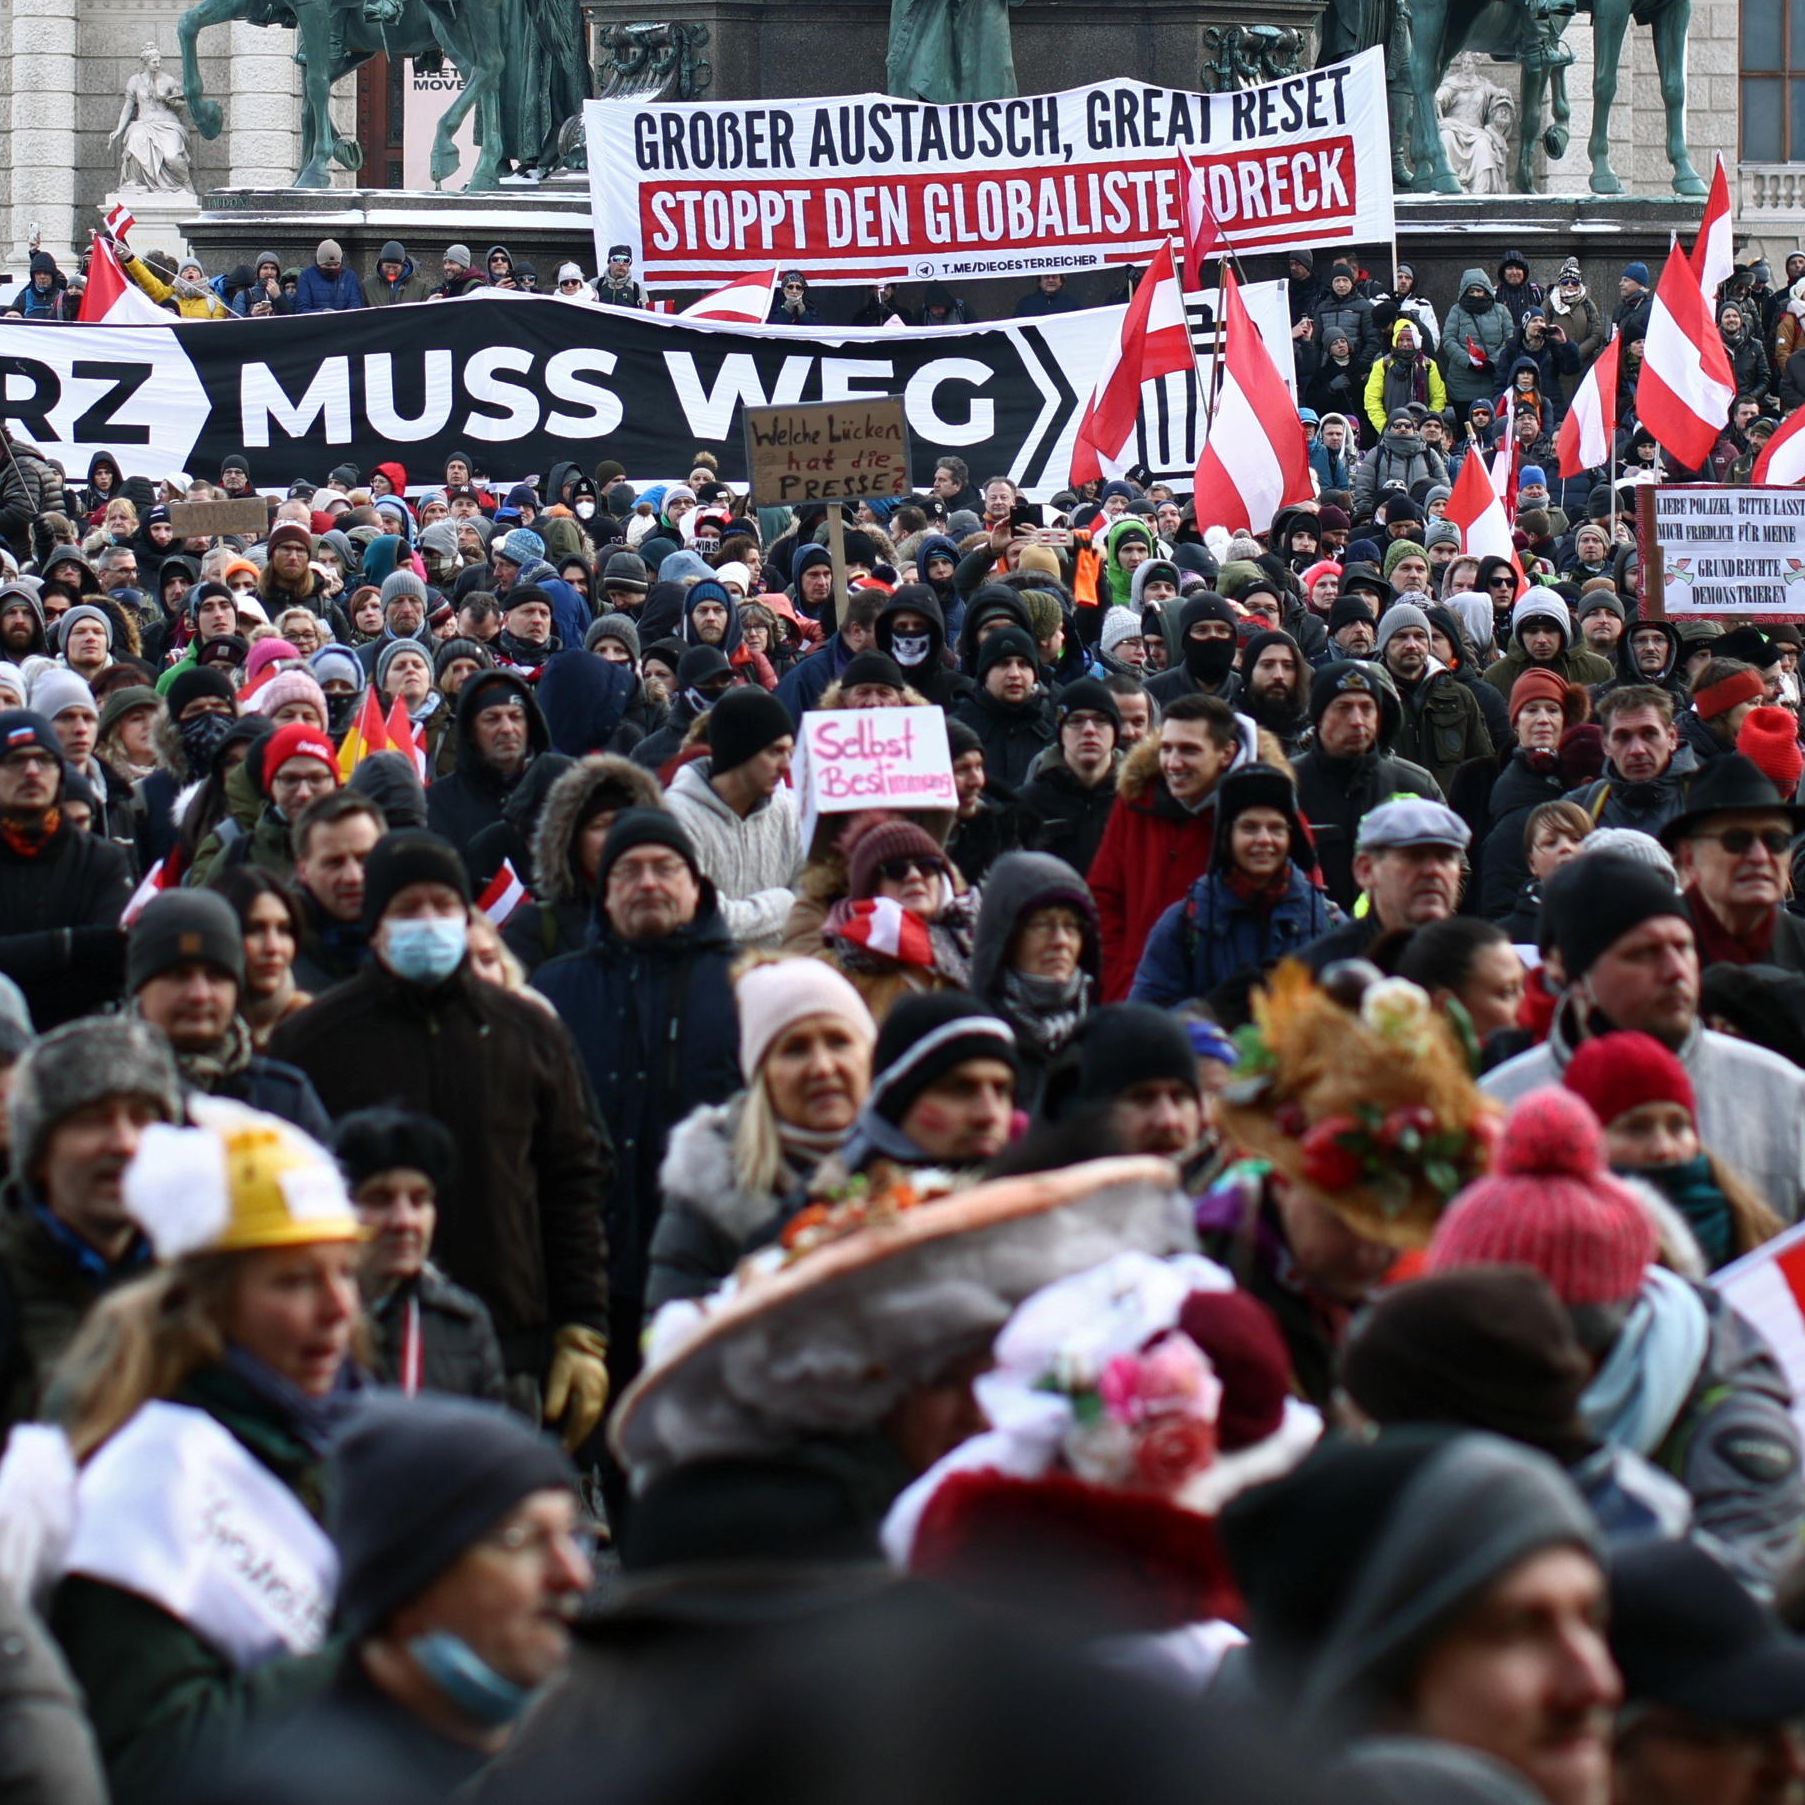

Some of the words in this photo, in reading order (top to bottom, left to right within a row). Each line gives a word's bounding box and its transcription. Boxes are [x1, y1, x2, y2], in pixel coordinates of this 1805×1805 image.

[808, 96, 1075, 168] AUSTAUSCH,
[1231, 64, 1352, 142] RESET
[650, 188, 813, 253] STOPPT
[823, 184, 910, 249] DEN
[241, 346, 625, 448] MUSS
[662, 350, 995, 447] WEG
[750, 415, 821, 447] Welche
[827, 413, 902, 444] Lücken
[787, 449, 835, 472] hat
[851, 449, 892, 469] die
[1656, 497, 1687, 516] LIEBE
[1689, 498, 1733, 518] POLIZEI,
[1738, 497, 1771, 516] BITTE
[1657, 523, 1683, 541] MICH
[1686, 525, 1734, 542] FRIEDLICH
[1738, 521, 1759, 543] FÜR
[1762, 525, 1796, 543] MEINE
[1697, 558, 1782, 578] GRUNDRECHTE
[1691, 585, 1787, 605] DEMONSTRIEREN
[813, 717, 916, 761] Selbst
